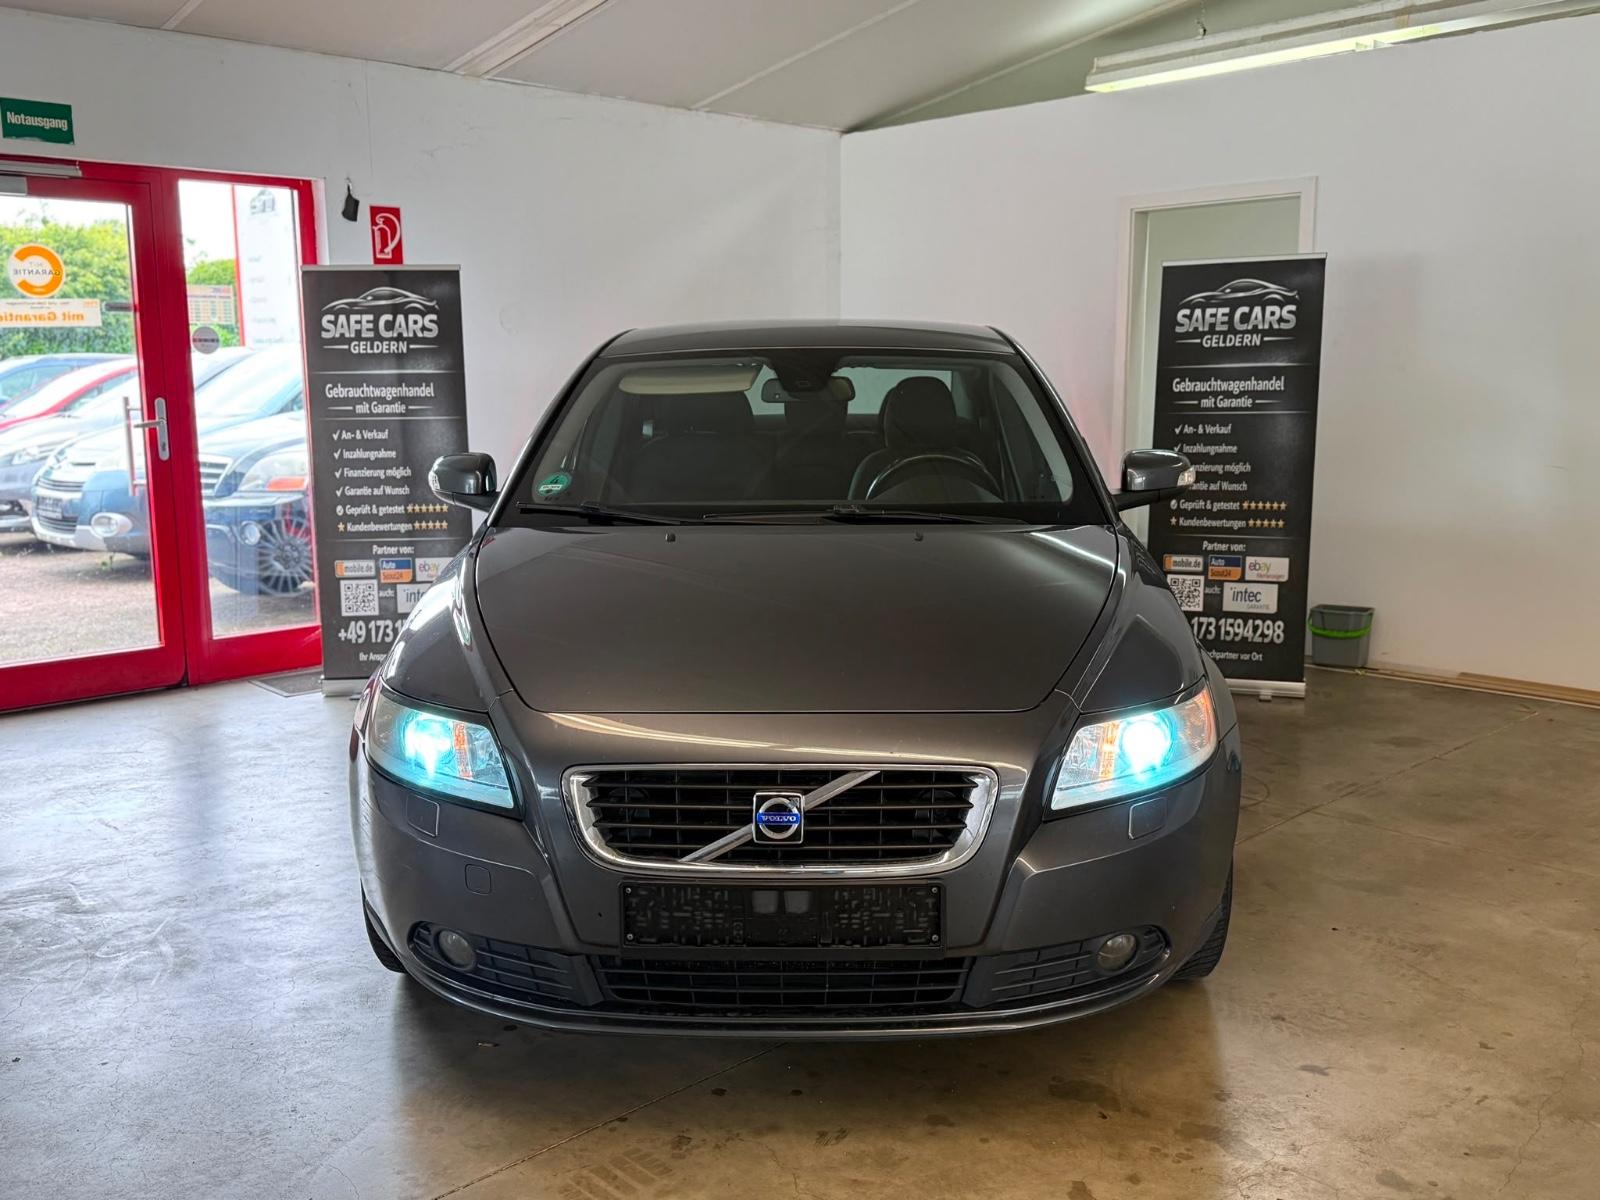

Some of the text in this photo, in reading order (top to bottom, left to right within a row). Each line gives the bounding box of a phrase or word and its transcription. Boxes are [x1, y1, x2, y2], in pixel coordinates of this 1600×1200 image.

[6, 111, 68, 131] Notausgang
[1175, 304, 1297, 333] SAFE CARS
[321, 314, 439, 338] SAFE CARS
[1202, 333, 1261, 347] GELDERN
[350, 341, 408, 354] GELDERN
[325, 382, 435, 401] Gebrauchtwagenhandel
[1172, 376, 1285, 395] Gebrauchtwagenhandel
[356, 401, 406, 414] mit Garantie
[1201, 395, 1252, 408] mit Garantie
[341, 429, 389, 440] An- & Verkauf
[1183, 423, 1232, 434] An- & Verkauf
[343, 448, 396, 461] Inzahlungnahme
[1182, 443, 1238, 456] Inzahlungnahme
[344, 467, 412, 479] Finanzierung möglich
[1194, 462, 1251, 475] nzierung möglich
[344, 485, 410, 497] Garantie auf Wunsch
[1209, 481, 1220, 491] auf
[1221, 480, 1248, 491] Wunsch
[345, 504, 405, 517] Geprüft & getestet
[1179, 499, 1240, 512] Geprüft & getestet
[347, 521, 413, 533] Kundenbewertungen
[1179, 517, 1247, 530] Kundenbewertungen
[372, 545, 414, 555] Partner von:
[1202, 540, 1246, 552] Partner von:
[1172, 558, 1201, 569] mobile.de
[1248, 560, 1271, 573] ebay
[1231, 587, 1262, 602] intec
[338, 620, 366, 643] +49
[368, 619, 394, 643] 173
[1218, 618, 1284, 645] 1594298
